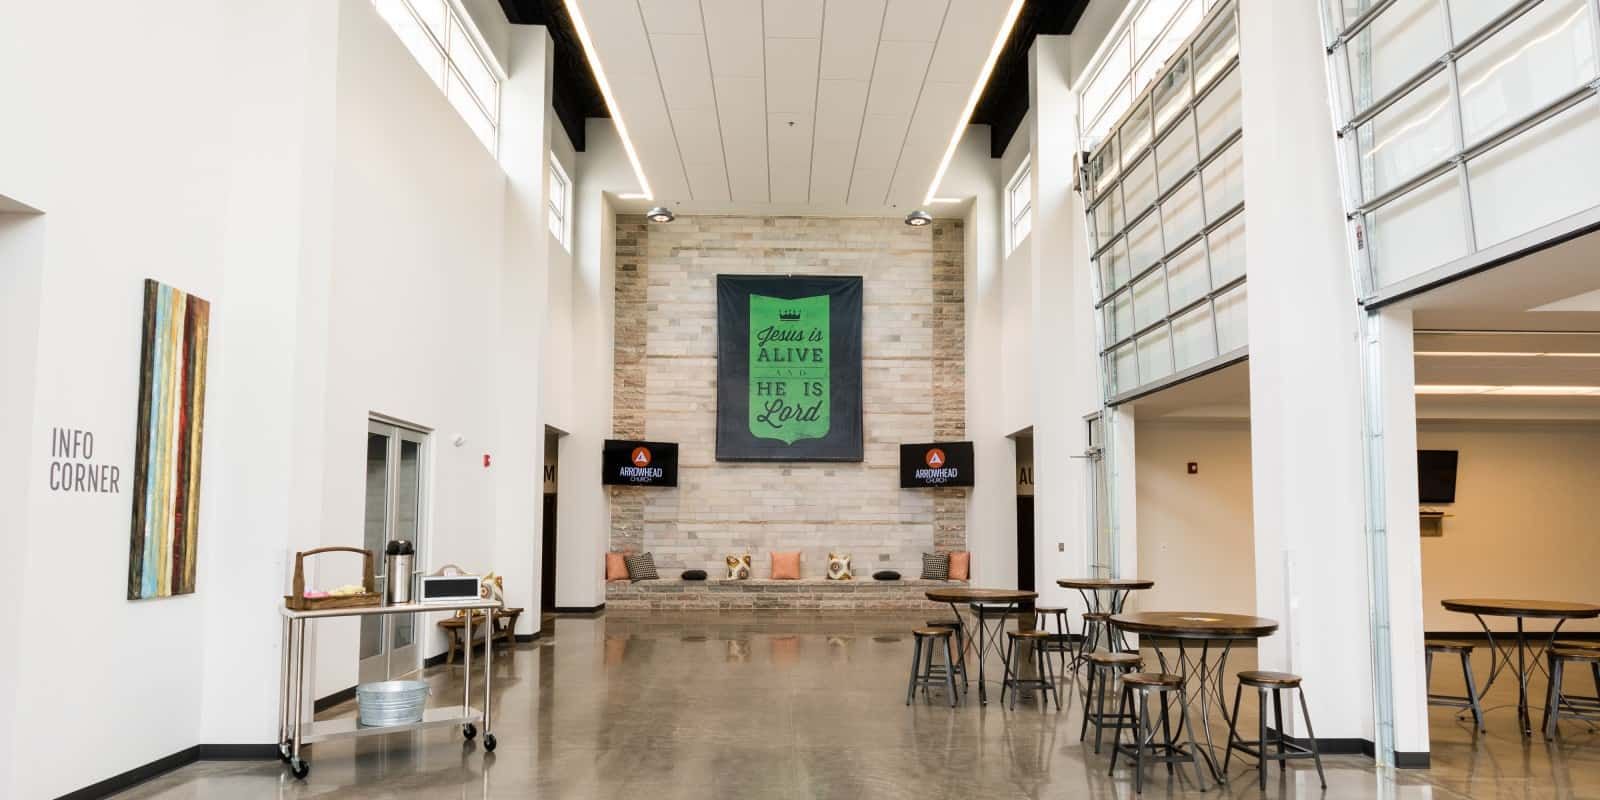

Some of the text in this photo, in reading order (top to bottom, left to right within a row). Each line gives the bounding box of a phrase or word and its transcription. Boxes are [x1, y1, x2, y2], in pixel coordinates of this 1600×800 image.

[756, 326, 823, 347] Jesus is
[757, 348, 824, 362] ALIVE
[775, 368, 807, 376] AND
[757, 381, 823, 397] HE IS
[756, 398, 823, 429] Lord
[52, 427, 94, 460] INFO
[50, 461, 120, 494] CORNER
[619, 466, 663, 478] ARROWHEAD
[915, 468, 958, 479] ARROWHEAD
